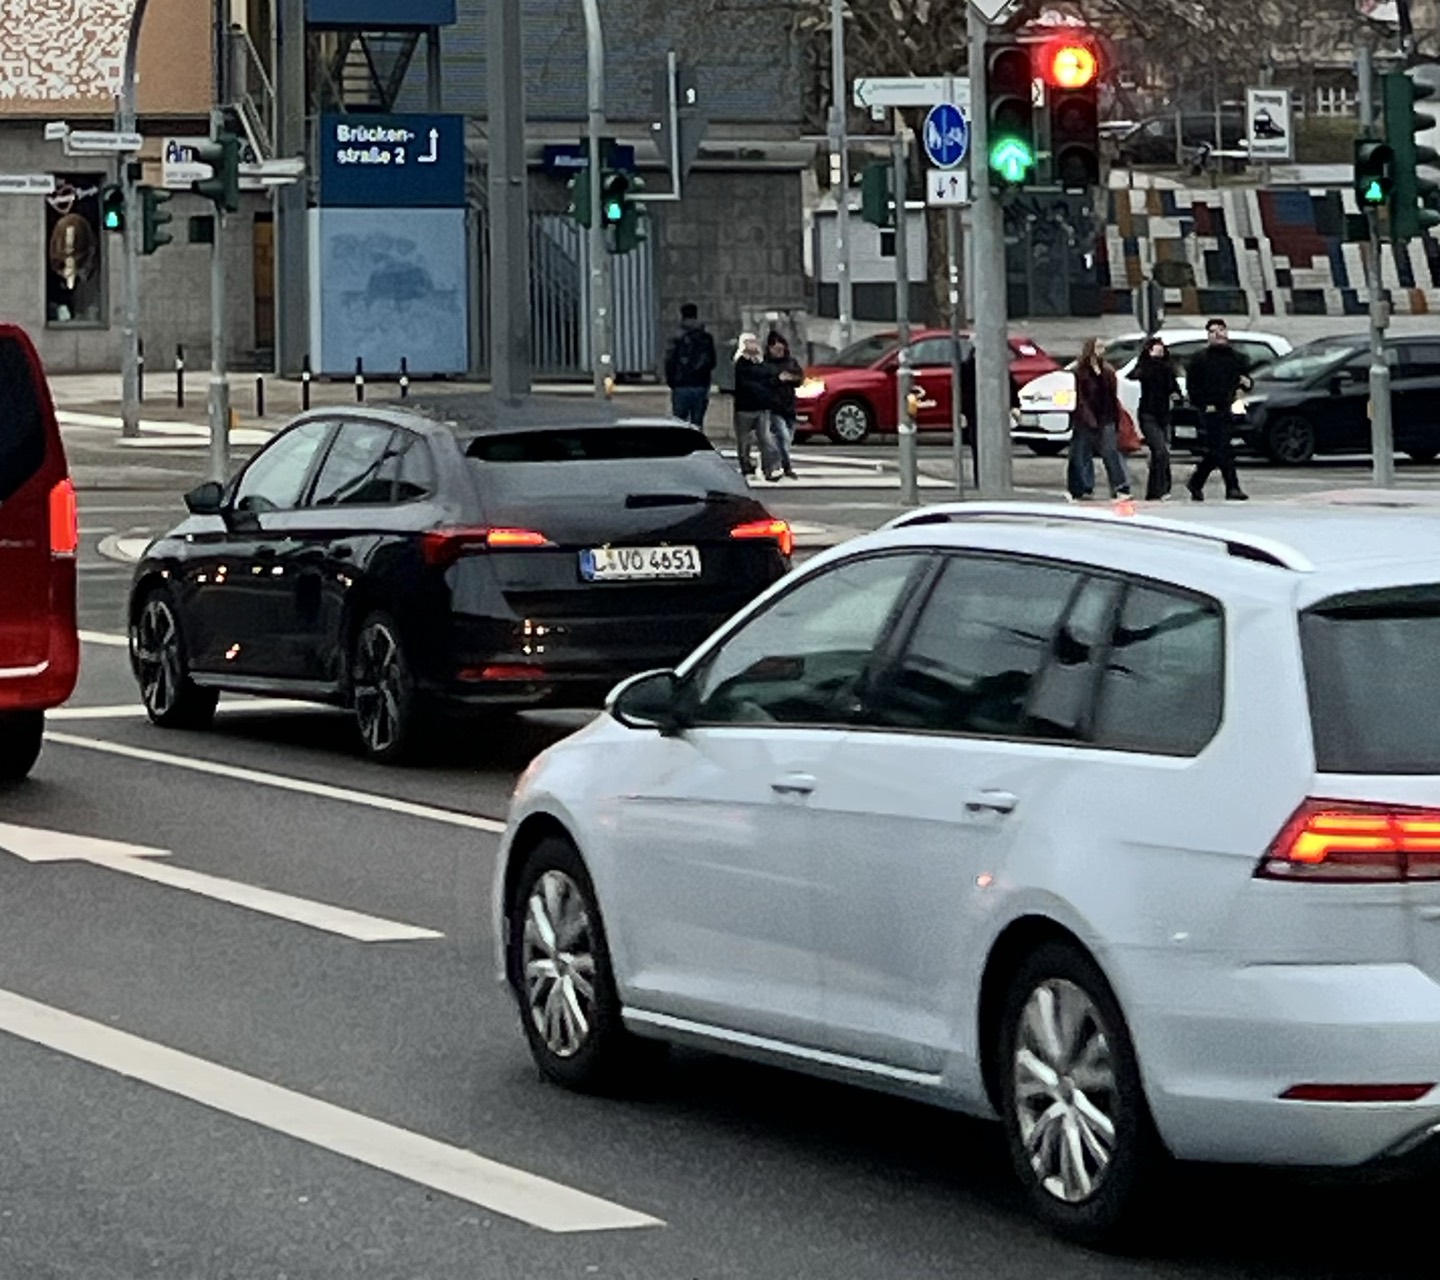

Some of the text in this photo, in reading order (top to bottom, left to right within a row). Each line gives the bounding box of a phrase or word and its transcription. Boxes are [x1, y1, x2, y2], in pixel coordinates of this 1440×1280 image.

[337, 125, 415, 142] Brücken-
[337, 146, 405, 164] straße 2
[592, 550, 607, 572] L
